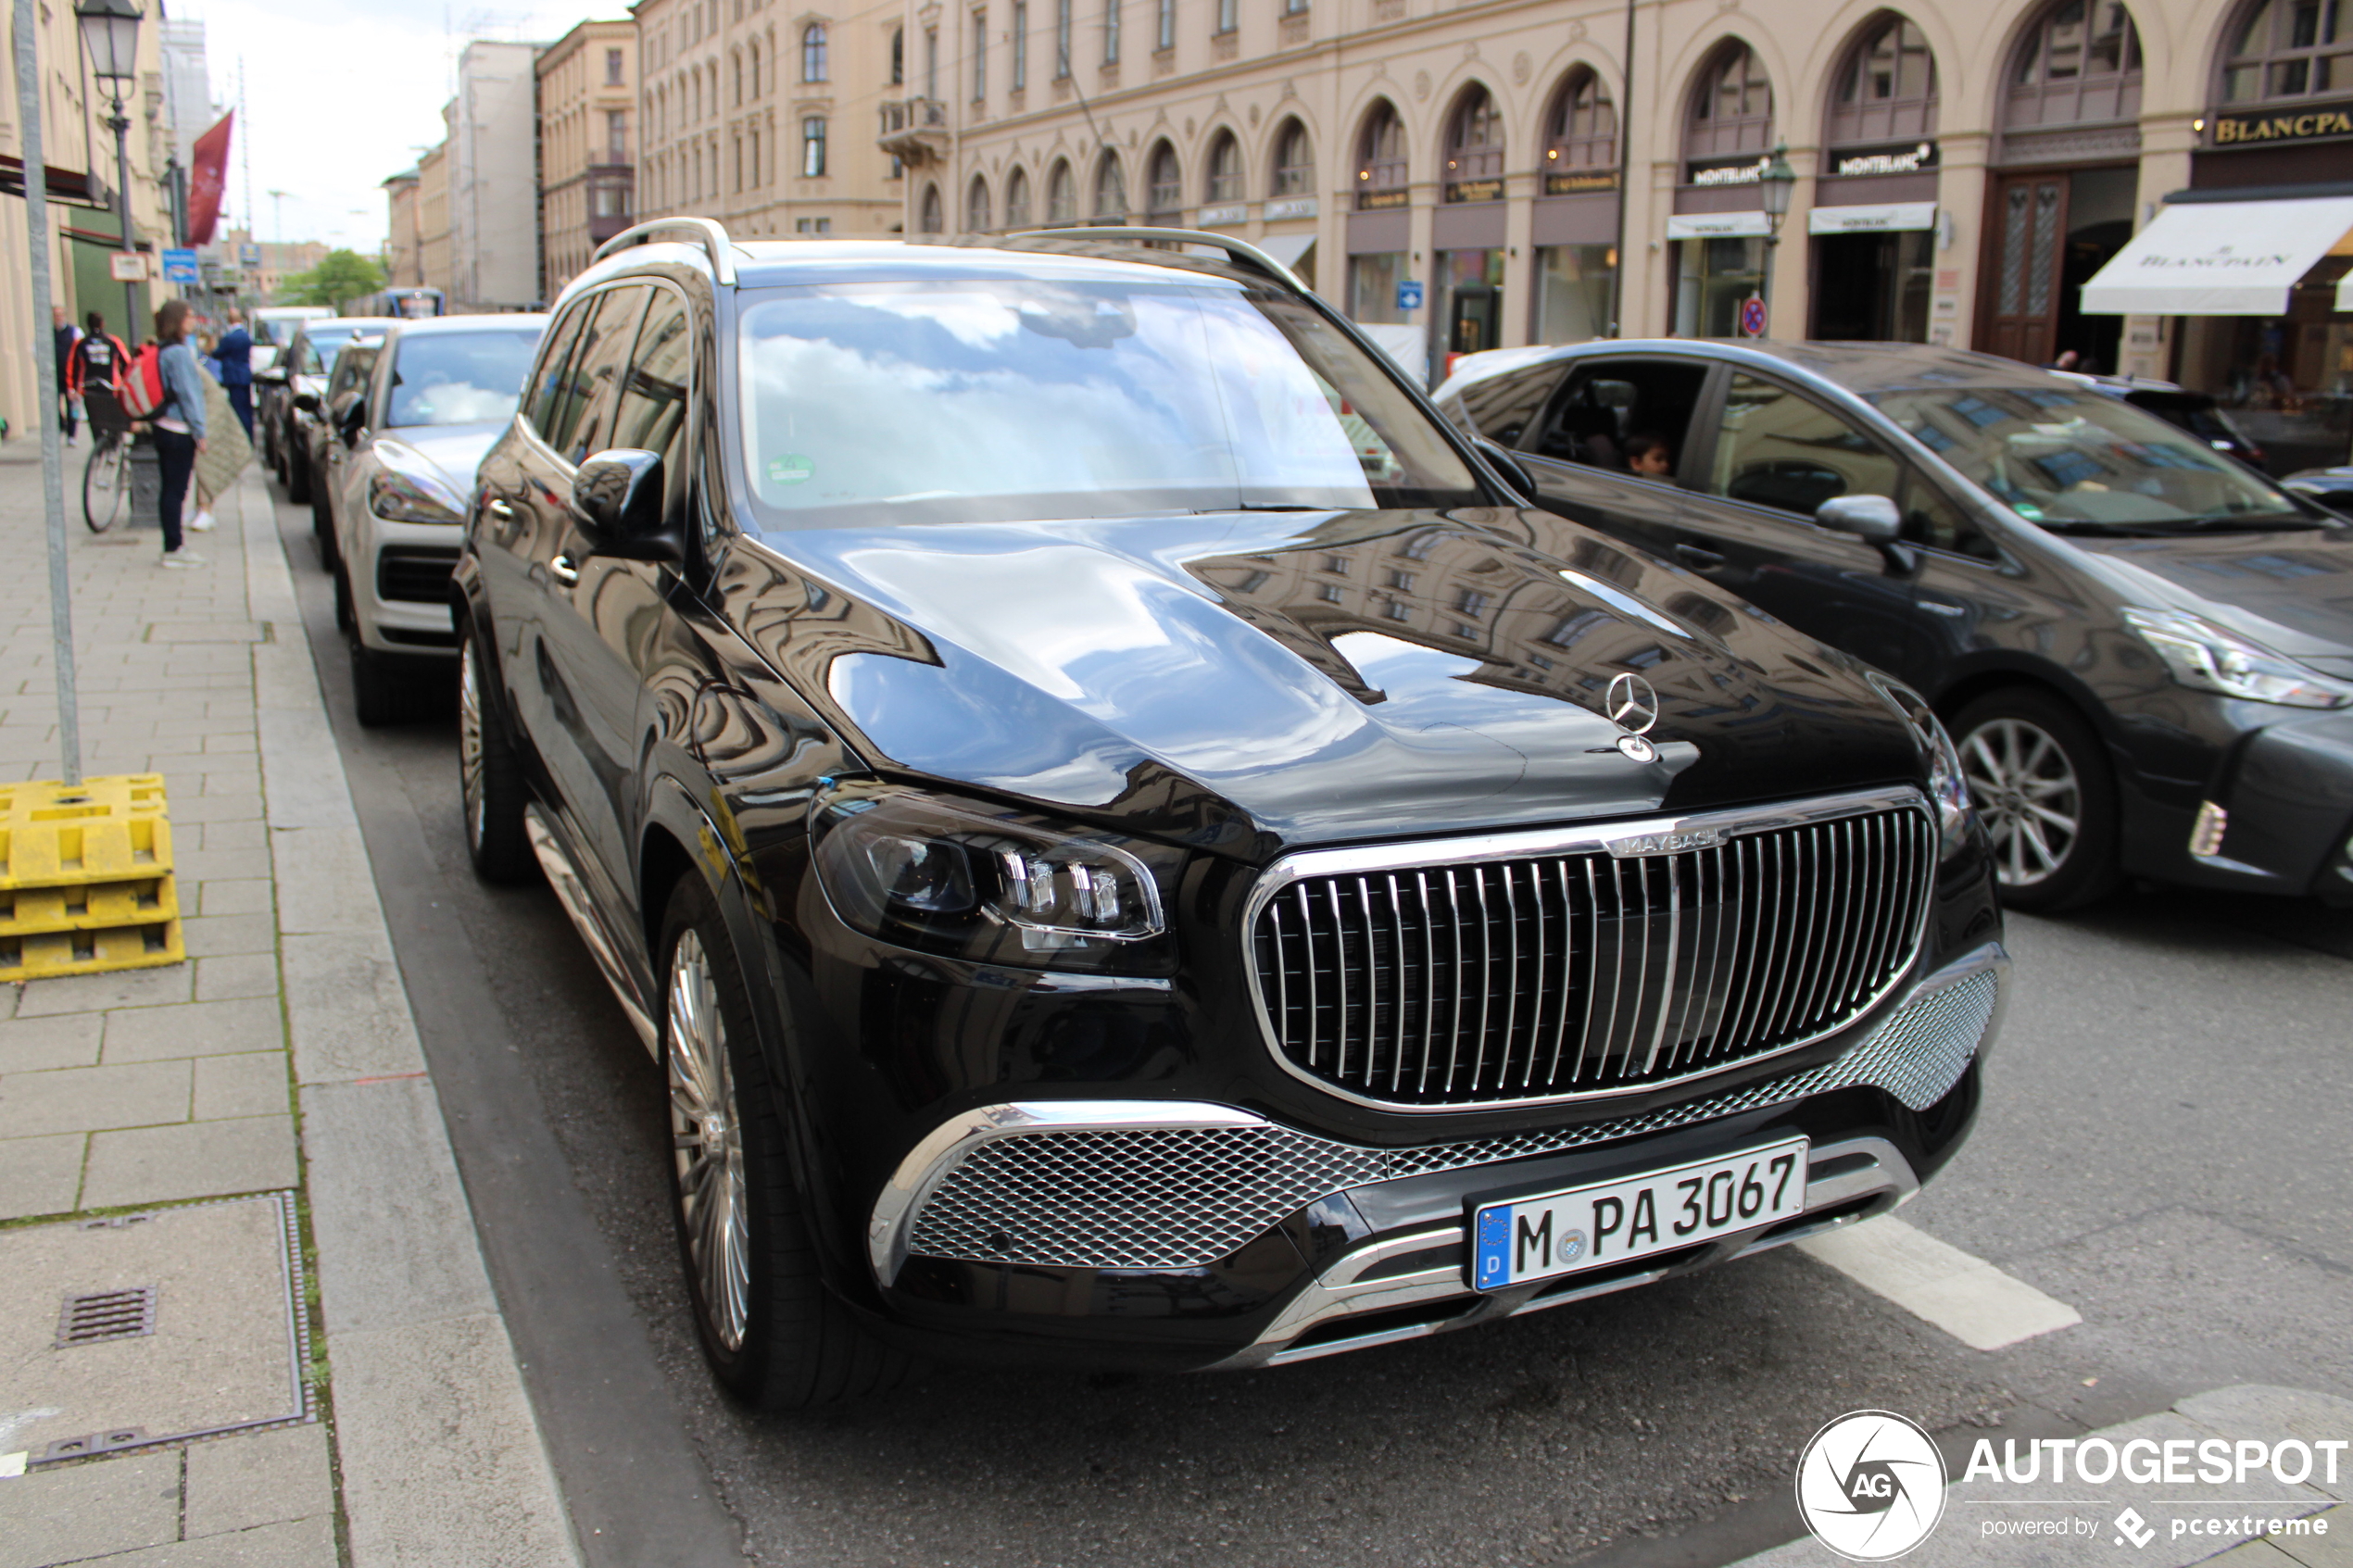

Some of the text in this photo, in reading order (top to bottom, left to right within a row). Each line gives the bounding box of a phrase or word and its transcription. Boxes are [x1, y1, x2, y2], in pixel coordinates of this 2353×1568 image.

[2216, 112, 2352, 143] BLANCPA
[1693, 165, 1761, 186] MONTBLANC
[1839, 152, 1919, 176] MONTBLANC
[1624, 828, 1720, 853] MAYBACH
[1516, 1210, 1552, 1273] M
[1592, 1188, 1658, 1256] PA
[1673, 1153, 1796, 1236] 3067
[1488, 1256, 1500, 1273] D
